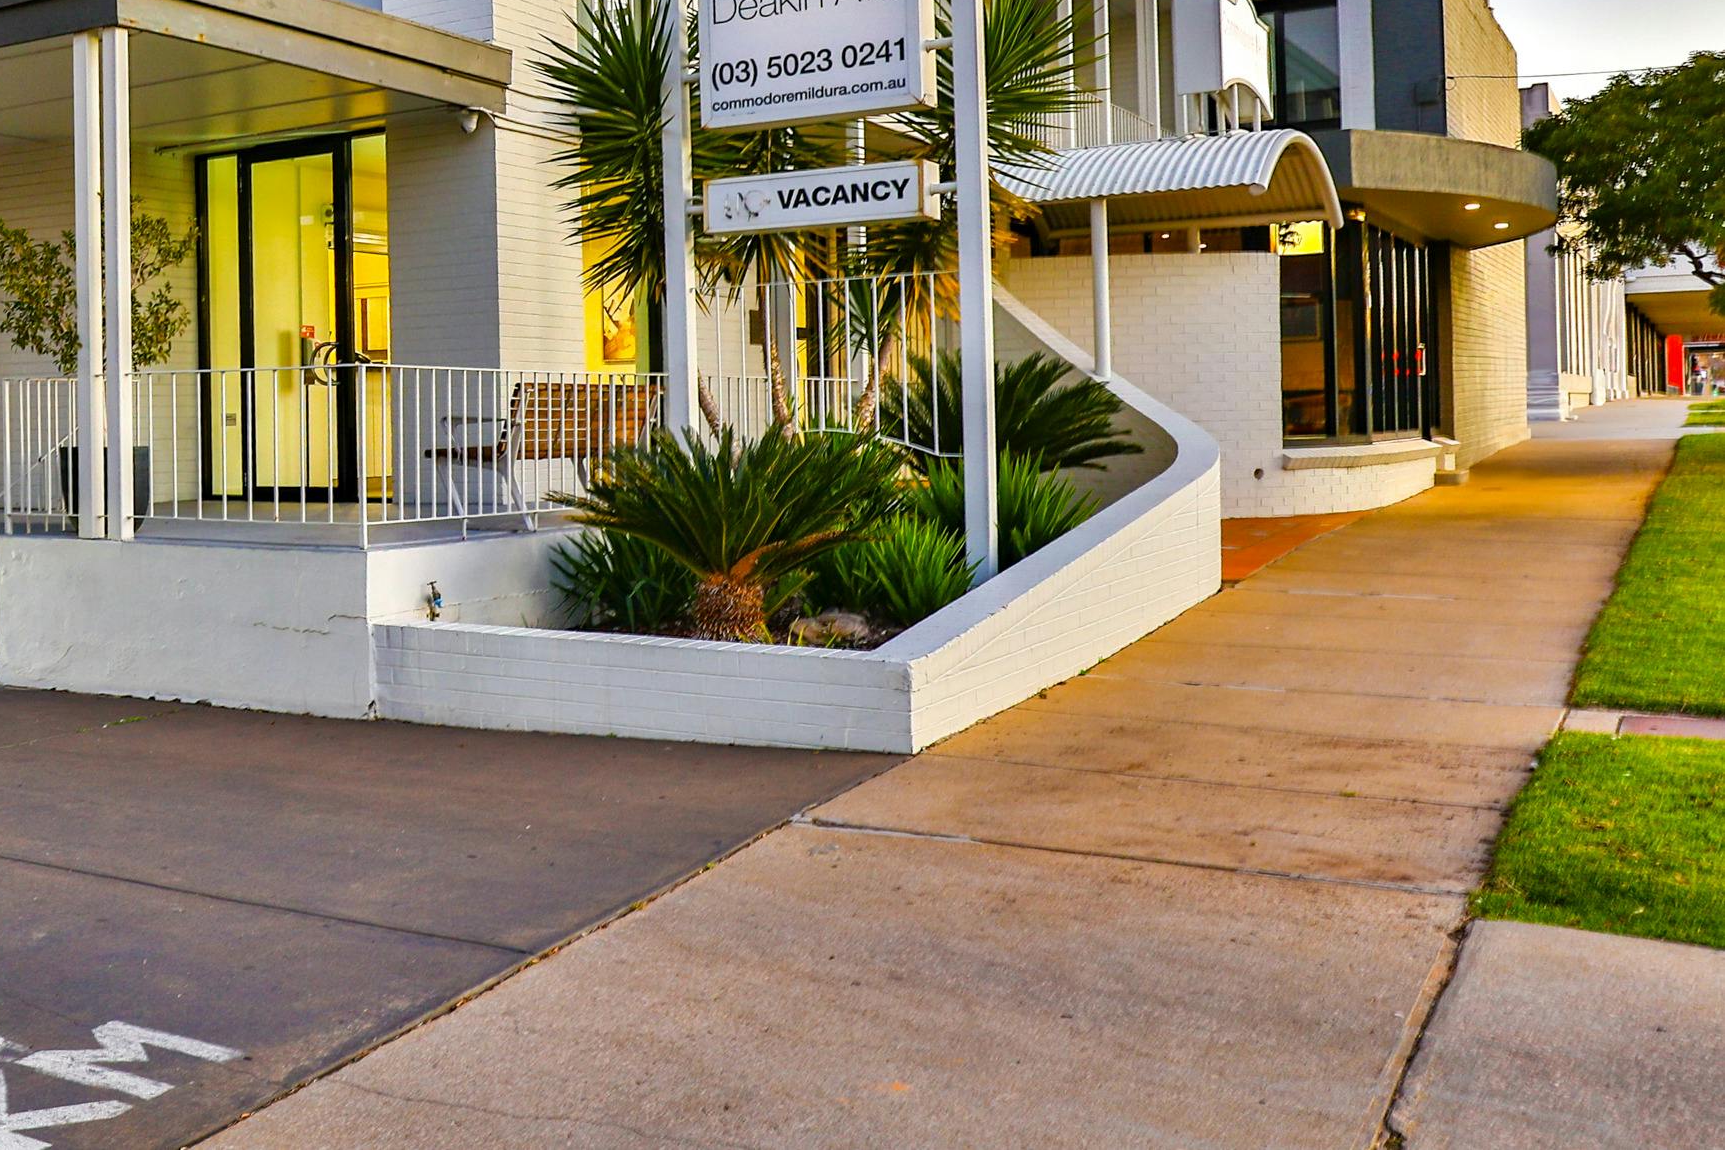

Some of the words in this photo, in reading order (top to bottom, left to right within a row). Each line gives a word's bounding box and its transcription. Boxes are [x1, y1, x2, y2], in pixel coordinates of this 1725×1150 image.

[711, 58, 758, 92] (03)
[766, 49, 833, 79] 5023
[841, 37, 906, 68] 0241
[711, 78, 906, 112] commodoremildura.com.au
[777, 178, 910, 210] VACANCY
